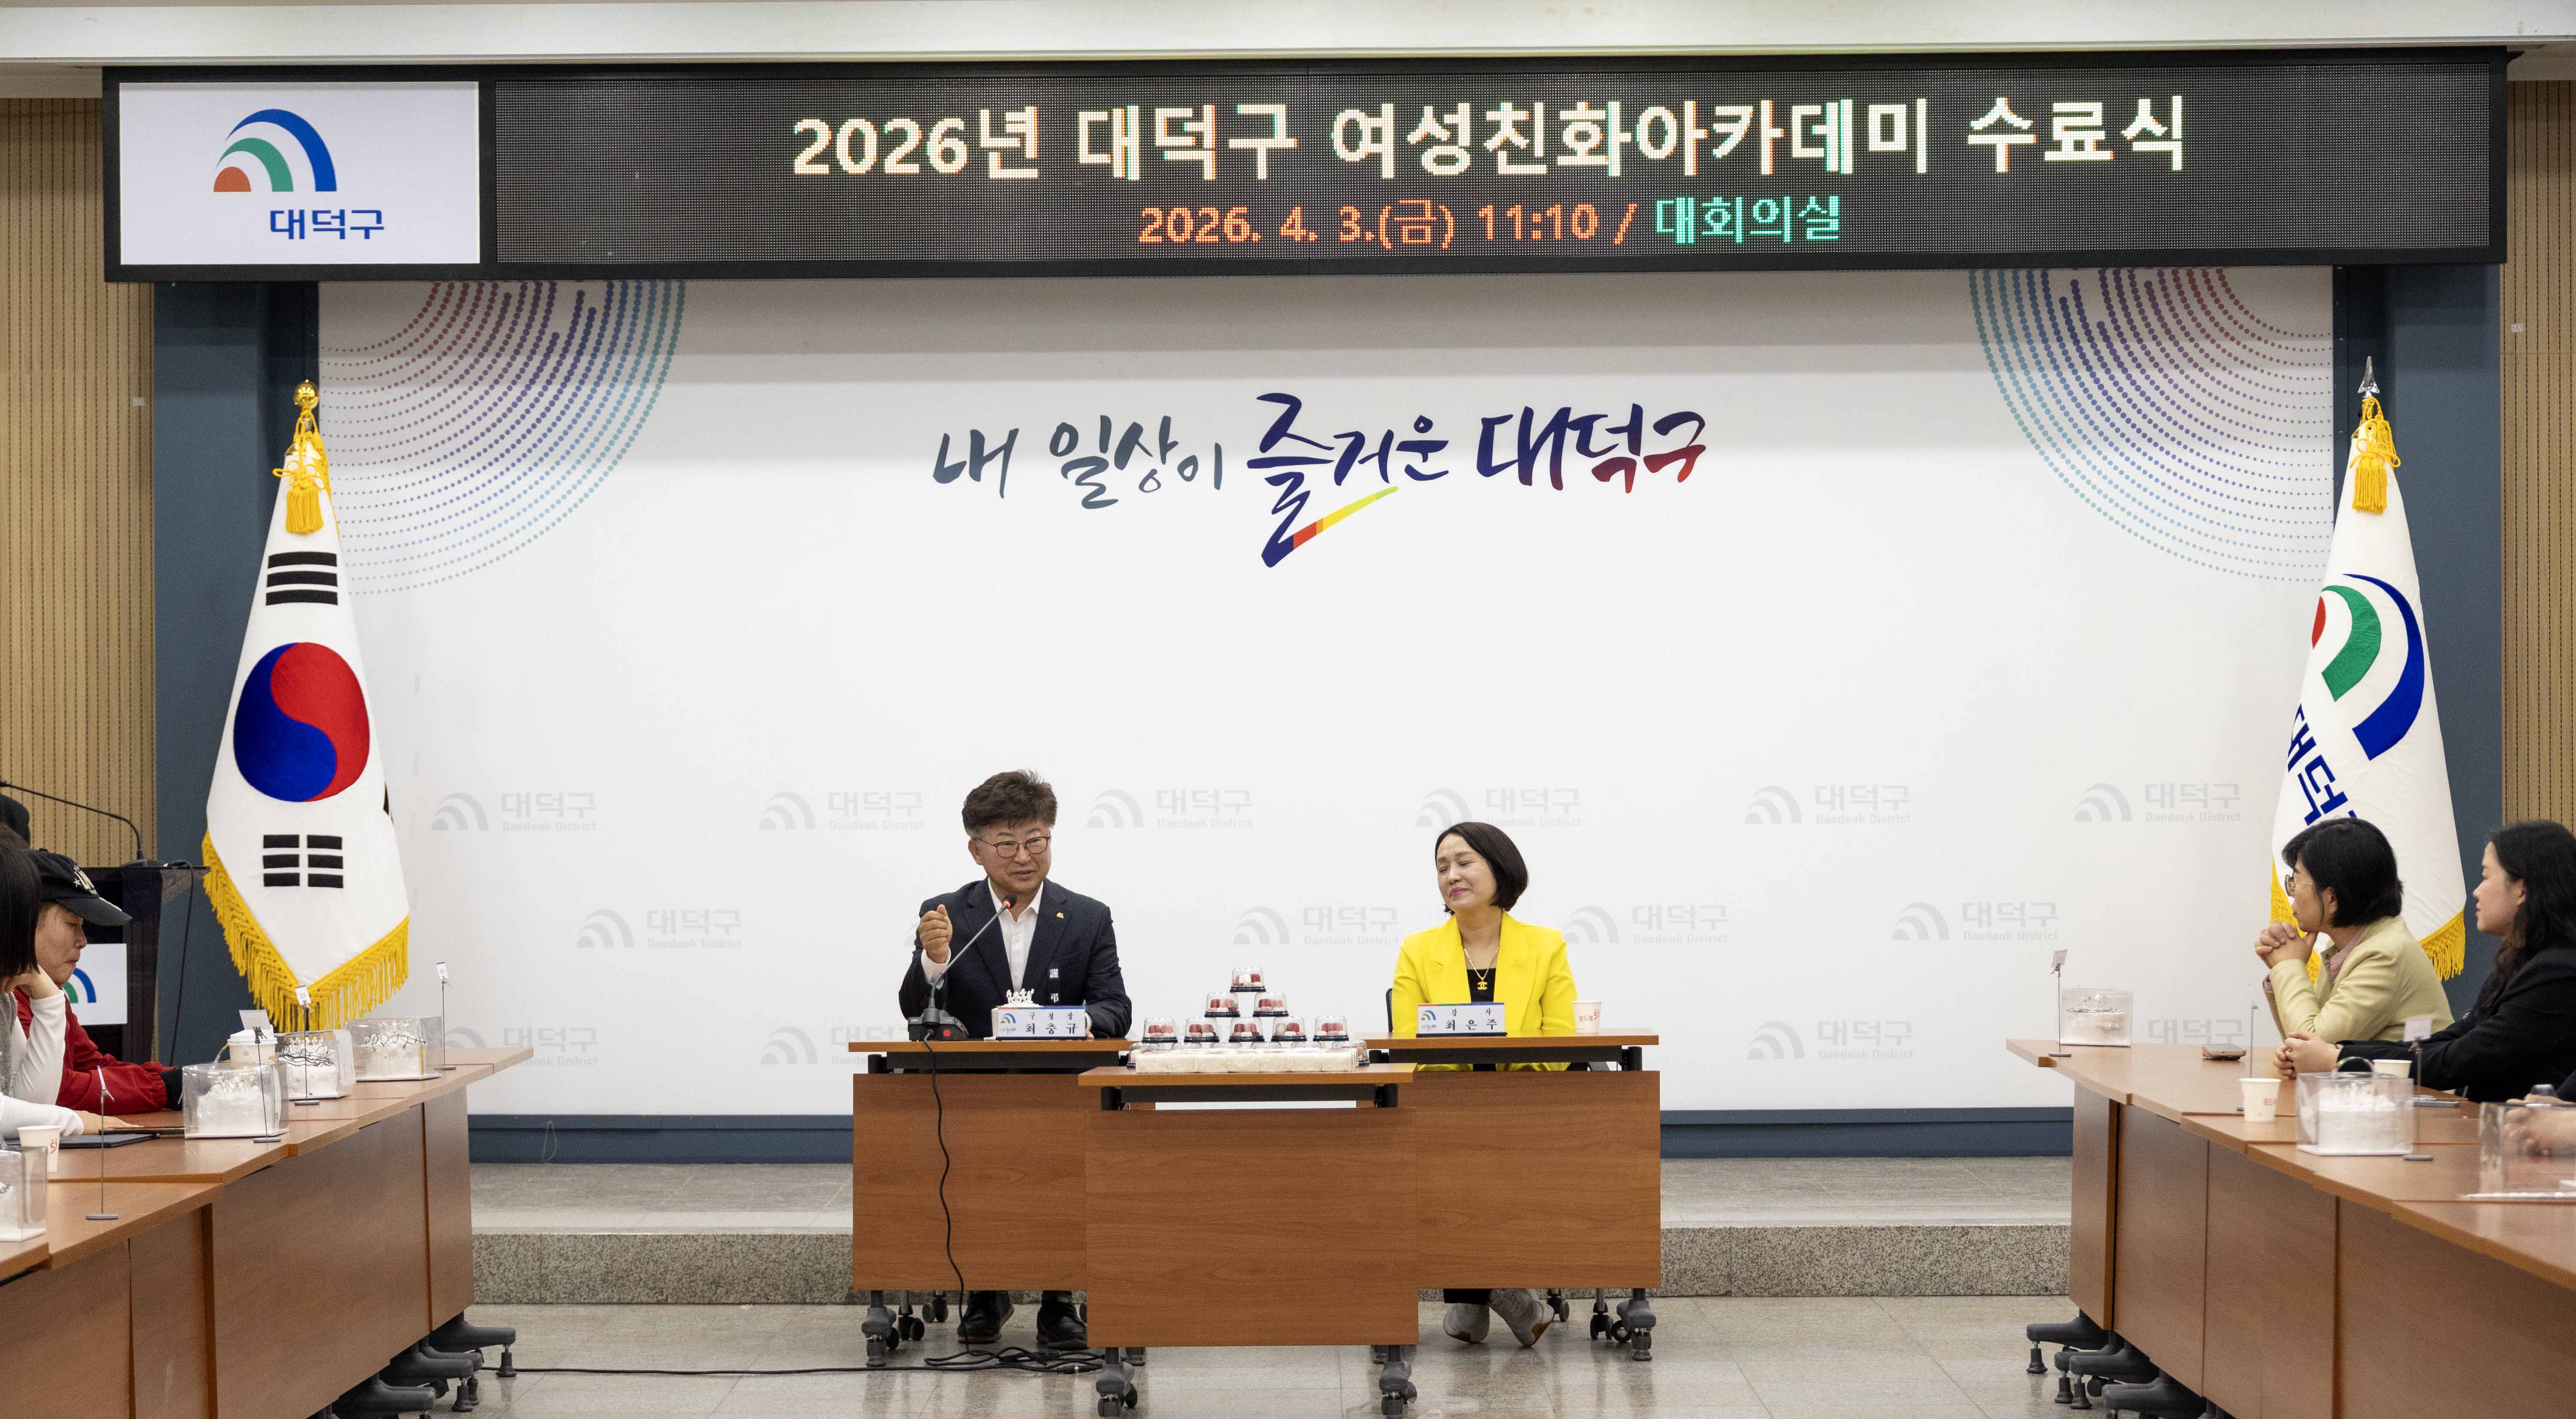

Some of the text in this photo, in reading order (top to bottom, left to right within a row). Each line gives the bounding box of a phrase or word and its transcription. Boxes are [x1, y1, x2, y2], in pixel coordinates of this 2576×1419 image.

[793, 95, 2183, 182] 2026년 대덕구 여성친화아카데미 수료식
[270, 209, 384, 240] 대덕구
[1139, 206, 1261, 244] 2026.
[1279, 206, 1318, 242] 4.
[1339, 199, 1455, 250] 3.(금)
[1478, 203, 1599, 241] 11:10
[1656, 195, 1840, 245] 대회의실
[933, 393, 1707, 567] 내 일상이 즐거운 대덕구
[2287, 703, 2357, 826] 대덕
[501, 792, 595, 818] 대덕구
[829, 792, 923, 817] 대덕구
[1157, 789, 1252, 815] 대덕구
[1485, 788, 1581, 813] 대덕구
[1815, 785, 1911, 810] 대덕구
[2145, 783, 2241, 808] 대덕구
[501, 821, 596, 831] Daedeok District
[830, 820, 923, 830] Daedeok District
[1158, 818, 1252, 828] Daedeok District
[1540, 817, 1581, 827] District
[1816, 814, 1910, 824] Daedeok District
[2146, 812, 2241, 822] Daedeok District
[647, 909, 741, 935] 대덕구
[1303, 907, 1398, 932] 대덕구
[1632, 905, 1728, 930] 대덕구
[1962, 902, 2058, 928] 대덕구
[648, 938, 741, 948] Daedeok District
[1304, 935, 1398, 945] Daedeok District
[1634, 934, 1728, 944] Daedeok District
[1963, 931, 2058, 941] Daedeok District
[503, 1027, 598, 1052] 대덕구
[1818, 1020, 1914, 1046] 대덕구
[2148, 1019, 2244, 1044] 대덕구
[557, 1055, 598, 1066] District
[1819, 1049, 1913, 1060] Daedeok District
